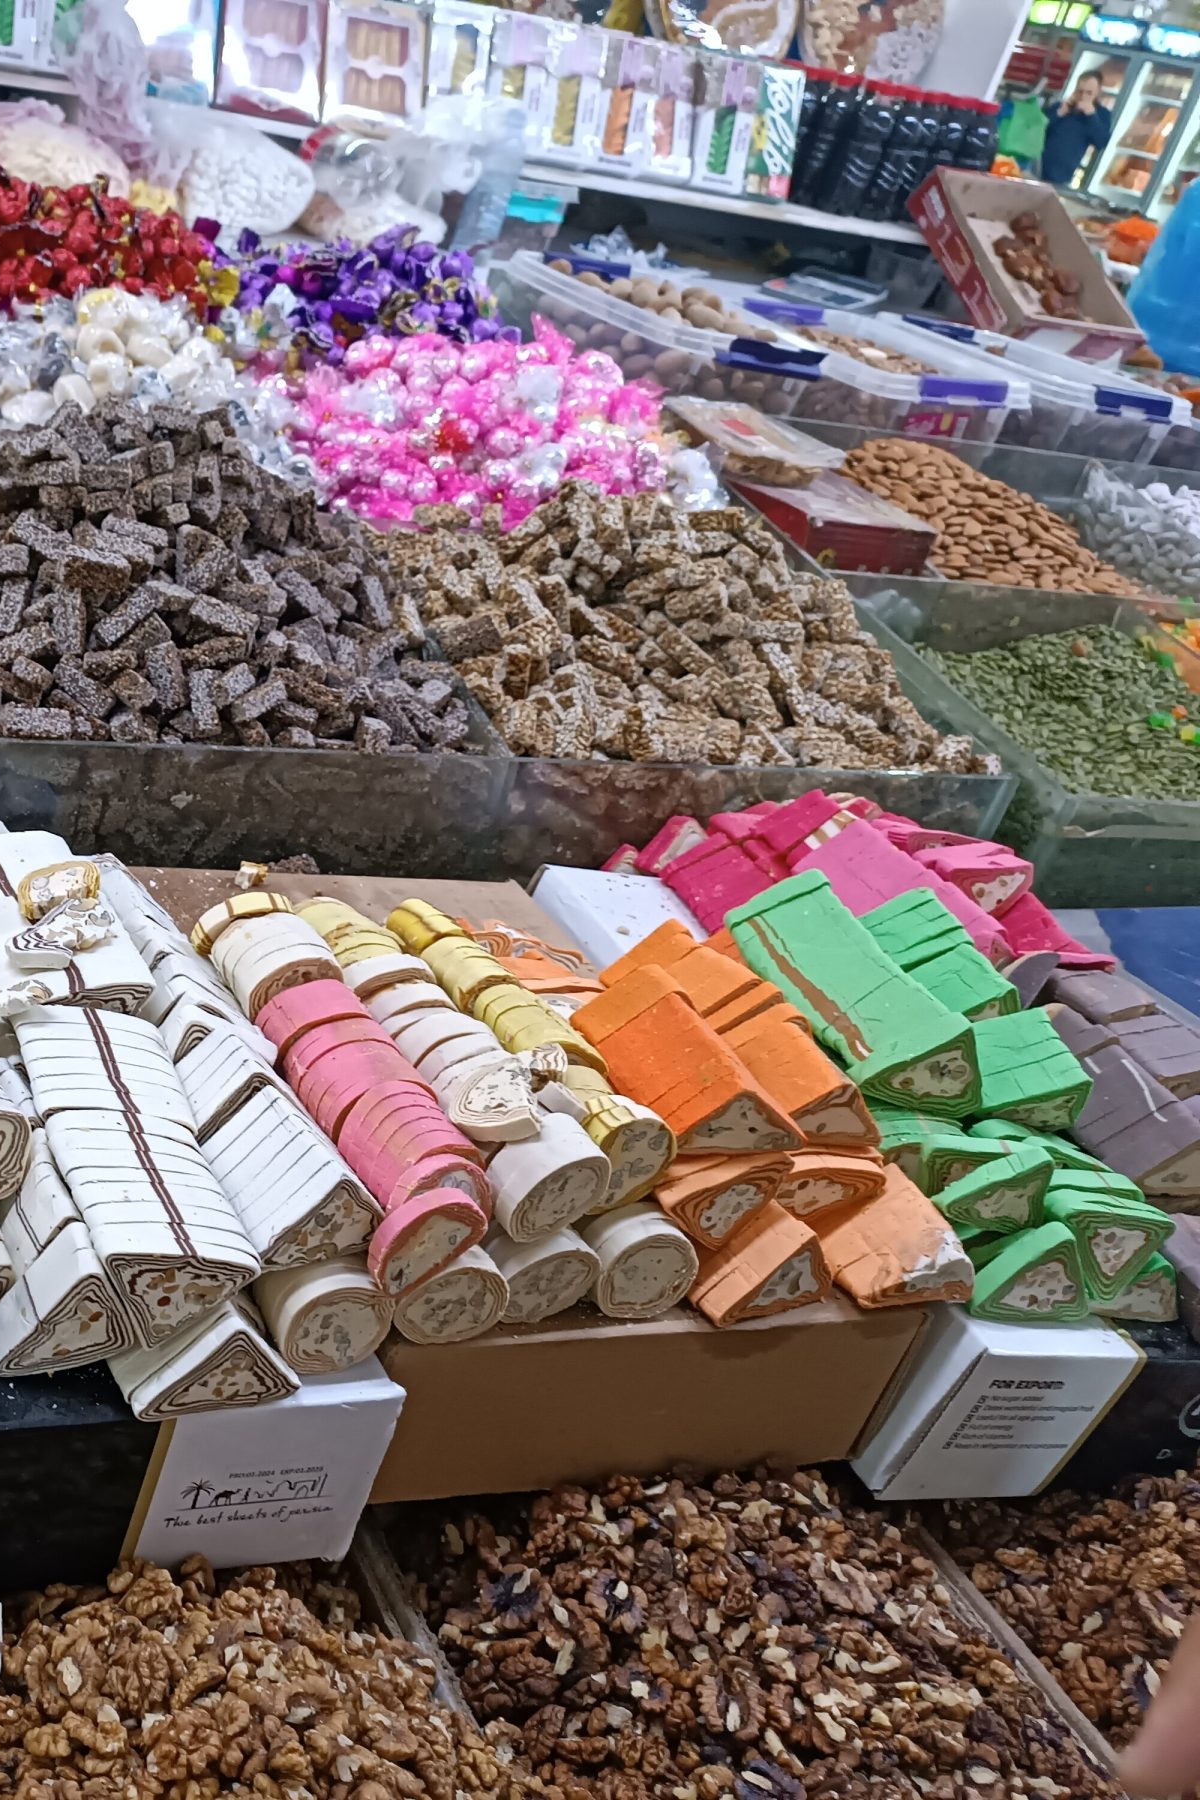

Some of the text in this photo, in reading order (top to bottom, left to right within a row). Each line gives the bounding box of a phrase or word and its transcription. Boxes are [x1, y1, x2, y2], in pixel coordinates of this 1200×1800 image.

[989, 1379, 1014, 1390] FOR
[196, 1510, 223, 1526] best
[271, 1505, 287, 1518] of
